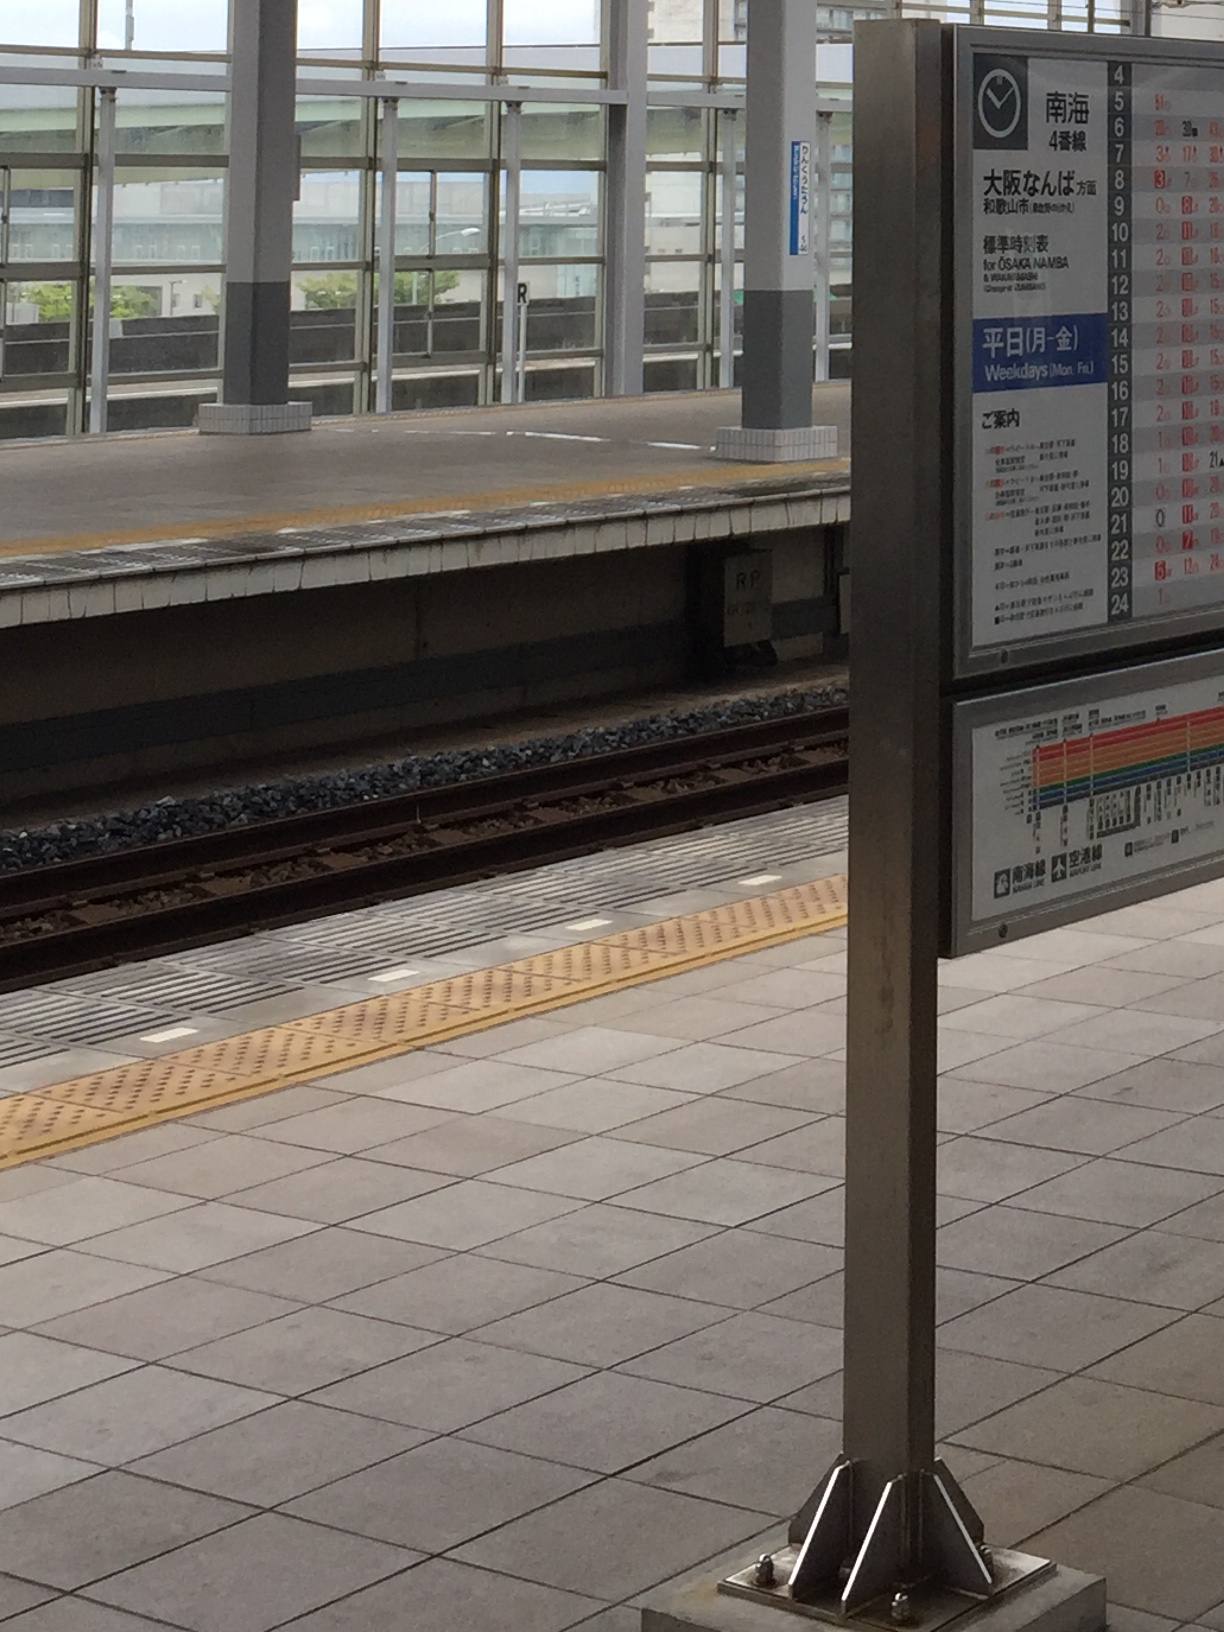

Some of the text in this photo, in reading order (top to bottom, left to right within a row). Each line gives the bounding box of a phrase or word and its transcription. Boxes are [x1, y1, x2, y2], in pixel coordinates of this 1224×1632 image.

[1115, 66, 1123, 83] 4
[1046, 92, 1090, 125] 南海
[1115, 91, 1123, 110] 5
[1115, 118, 1123, 136] 6
[1050, 130, 1087, 153] 4番線
[1116, 144, 1123, 162] 7
[1115, 170, 1124, 189] 8
[1115, 196, 1124, 215] 9
[1112, 223, 1128, 242] 10
[983, 235, 1048, 254] 標準時刻表
[1112, 249, 1126, 268] 11
[517, 283, 527, 303] R
[1112, 275, 1128, 294] 12
[1112, 302, 1128, 320] 13
[1112, 328, 1128, 347] 14
[985, 362, 1049, 382] Weekdays
[1112, 355, 1128, 373] 15
[1112, 381, 1128, 400] 16
[982, 408, 1020, 429] ご案内
[1112, 407, 1128, 427] 17
[1113, 433, 1128, 453] 18
[1112, 460, 1128, 480] 19
[1112, 487, 1128, 507] 20
[1112, 514, 1126, 534] 21
[1112, 540, 1128, 560] 22
[1112, 567, 1128, 588] 23
[1112, 594, 1128, 613] 24
[1069, 844, 1103, 868] 空港線
[1012, 859, 1046, 884] 南海線
